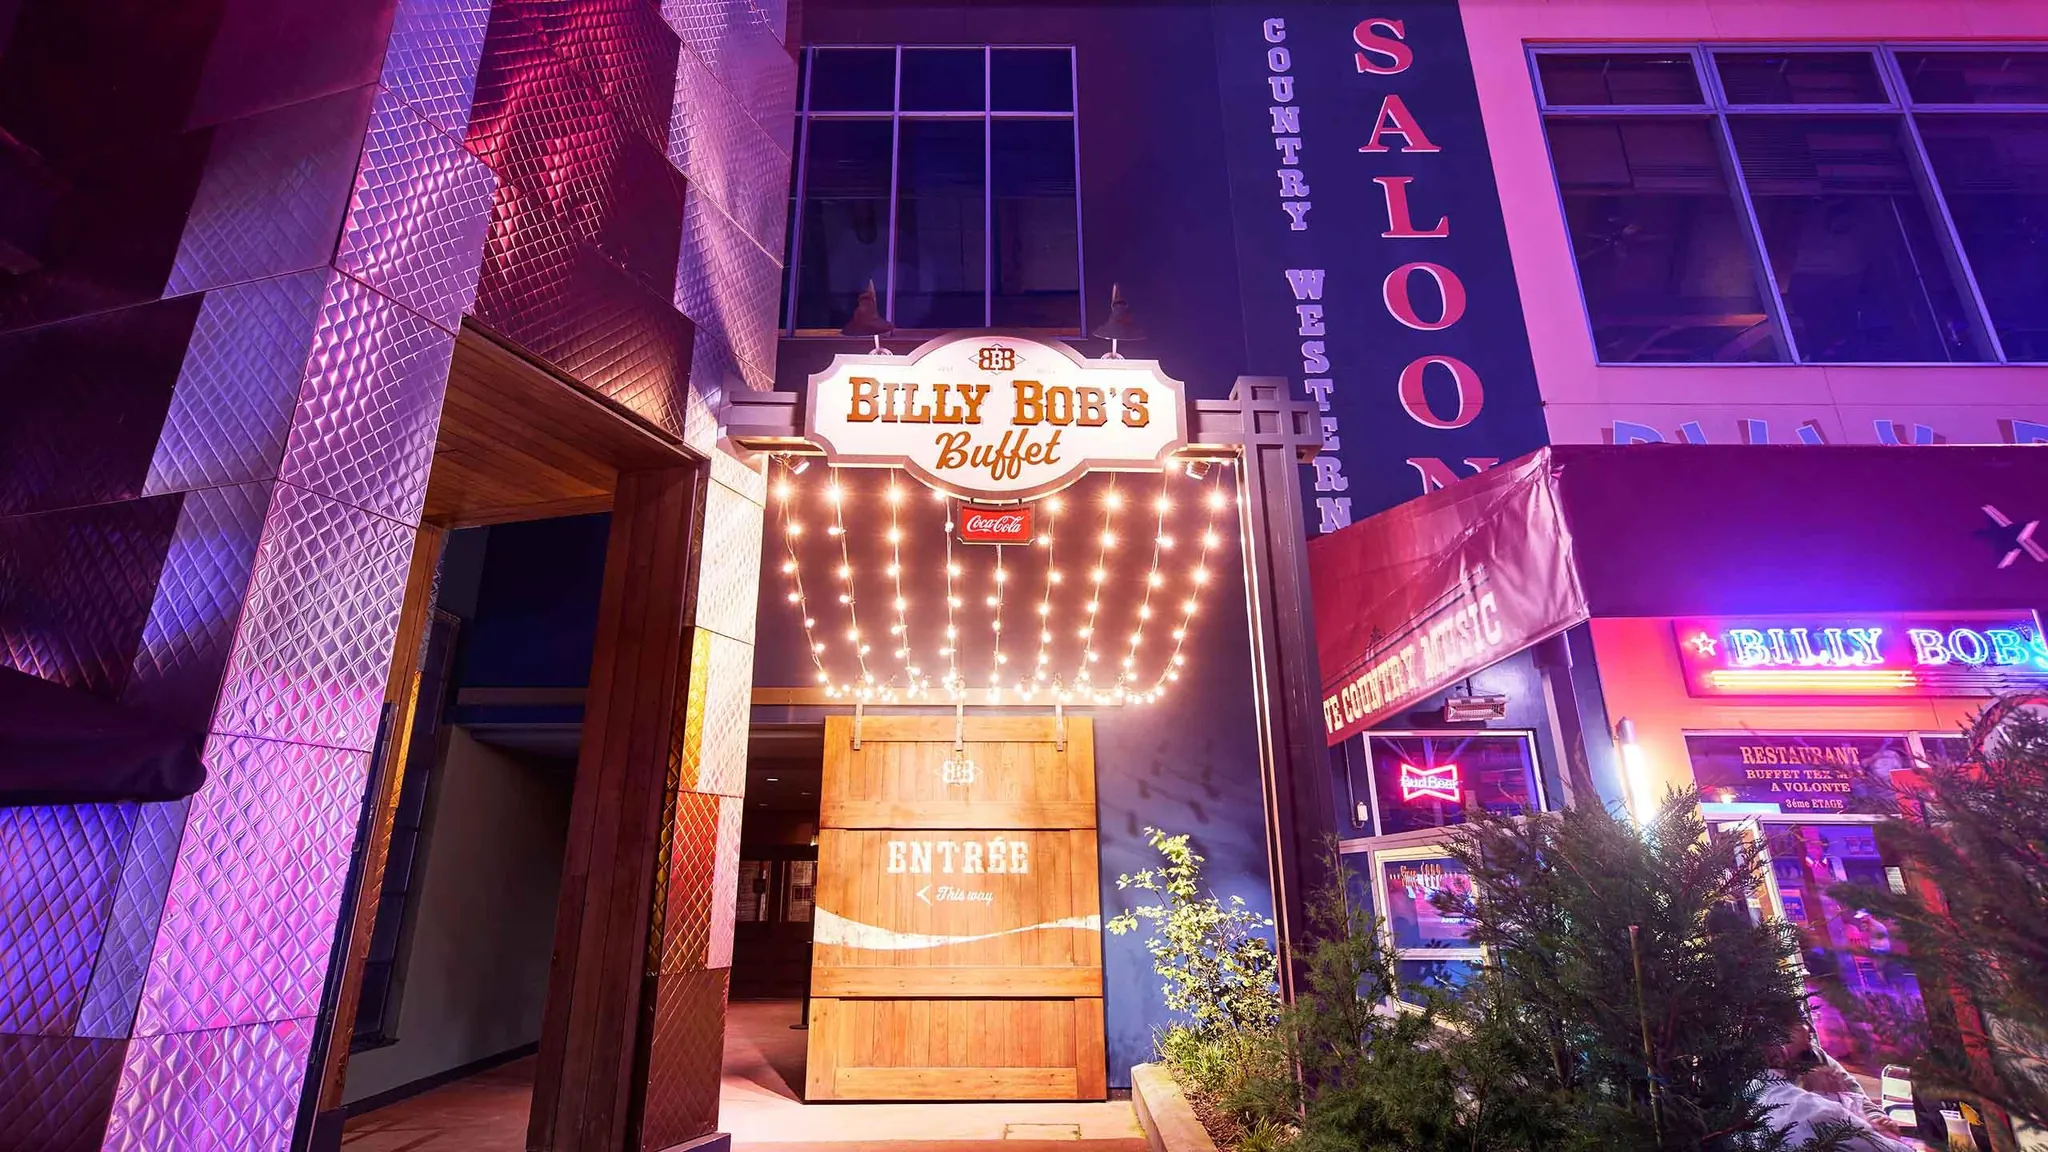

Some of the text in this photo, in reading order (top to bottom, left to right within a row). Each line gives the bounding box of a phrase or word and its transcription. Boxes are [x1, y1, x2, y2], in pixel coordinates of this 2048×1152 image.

[1263, 18, 1351, 533] COUNTRY WESTERN
[846, 376, 1151, 428] BILLY BOB'S
[935, 428, 1063, 481] Buffet
[966, 514, 1024, 533] Coca-Cola
[1341, 643, 1418, 724] COUNTRY
[1420, 591, 1501, 680] MUSIC
[1728, 627, 1885, 667] BILLY
[1740, 746, 1859, 766] RESTAURANT
[1746, 769, 1800, 779] BUFFET
[1804, 769, 1832, 779] TEX
[1771, 782, 1851, 792] A VOLONTE
[1813, 799, 1844, 809] ETAGE
[887, 836, 1029, 874] ENTRÉE
[936, 886, 994, 905] This way
